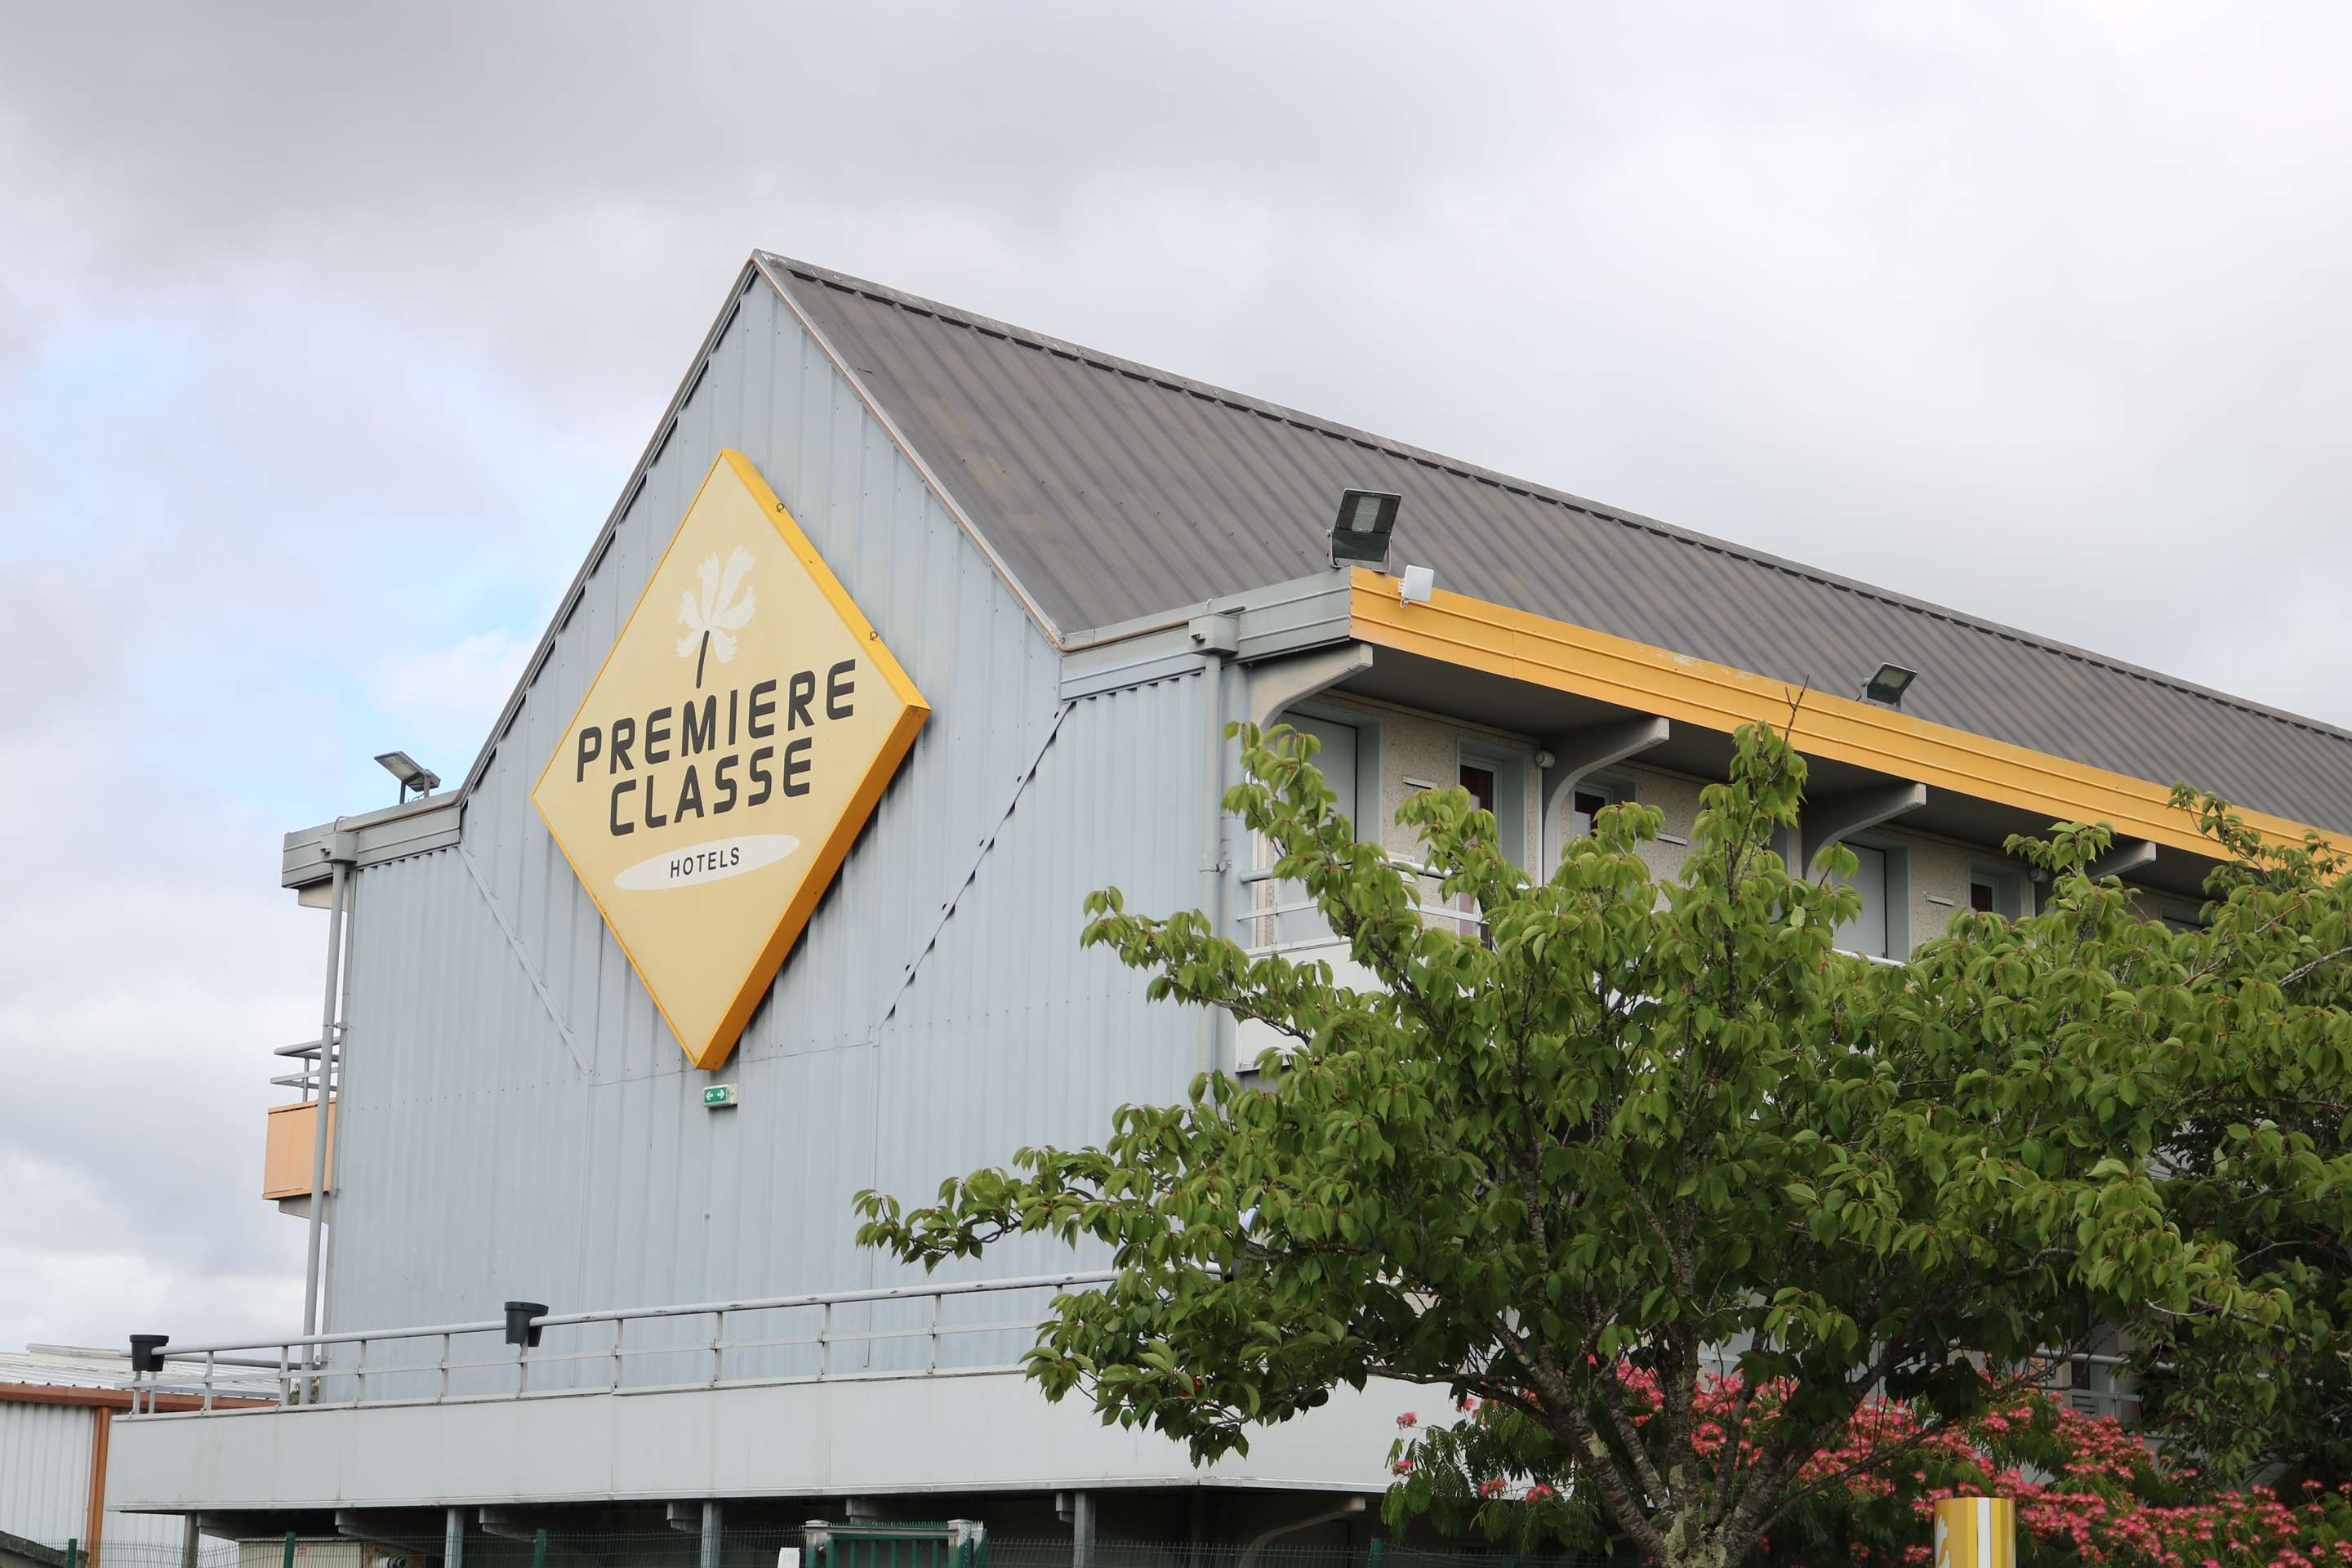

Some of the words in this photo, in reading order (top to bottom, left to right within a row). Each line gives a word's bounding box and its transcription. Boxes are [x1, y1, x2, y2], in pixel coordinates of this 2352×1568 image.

[577, 658, 856, 782] PREMIERE
[610, 737, 812, 836] CLASSE
[670, 847, 740, 878] HOTELS
